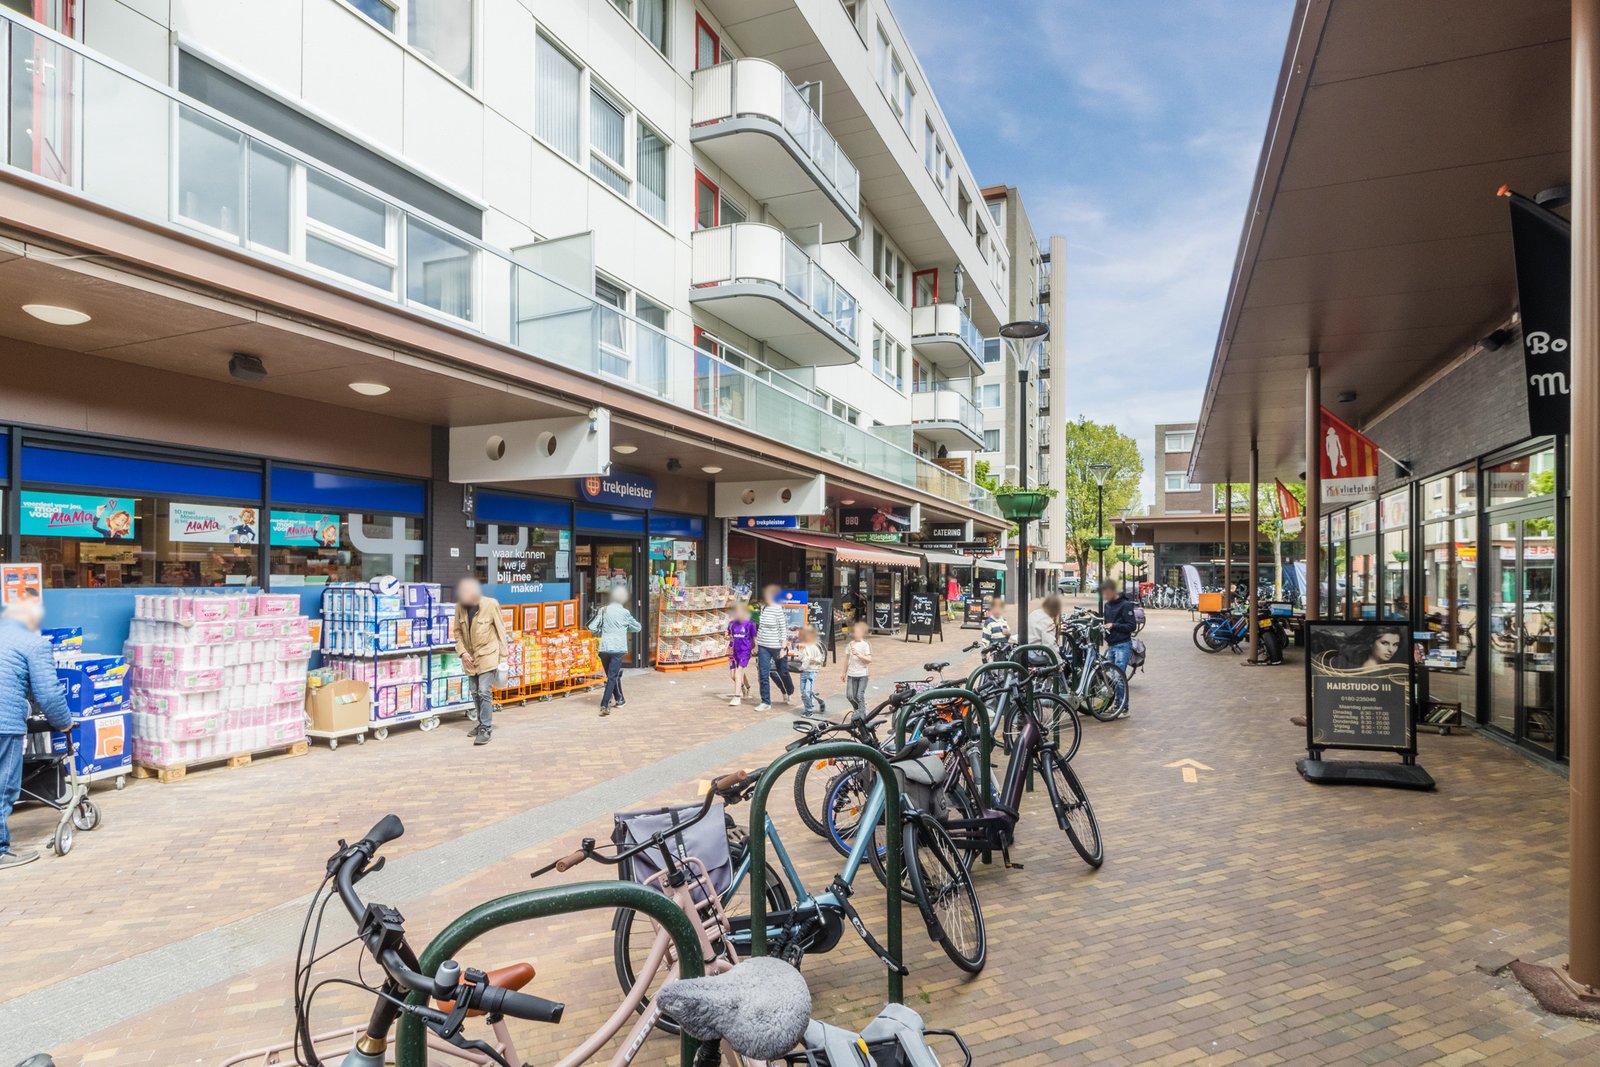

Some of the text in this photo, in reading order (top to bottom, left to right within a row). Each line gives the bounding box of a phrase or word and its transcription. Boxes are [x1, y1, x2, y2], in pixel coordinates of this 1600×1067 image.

[1529, 372, 1570, 396] M
[602, 480, 653, 499] trekpleister
[1341, 485, 1375, 493] vlietplein
[756, 519, 785, 527] trekpleister
[845, 516, 859, 525] BBQ
[933, 528, 961, 537] CATERING
[492, 550, 546, 559] waar kunnen
[504, 561, 526, 571] we je
[497, 572, 532, 583] blij mee
[510, 583, 543, 592] maken?
[1327, 682, 1379, 691] HAIRSTUDIO
